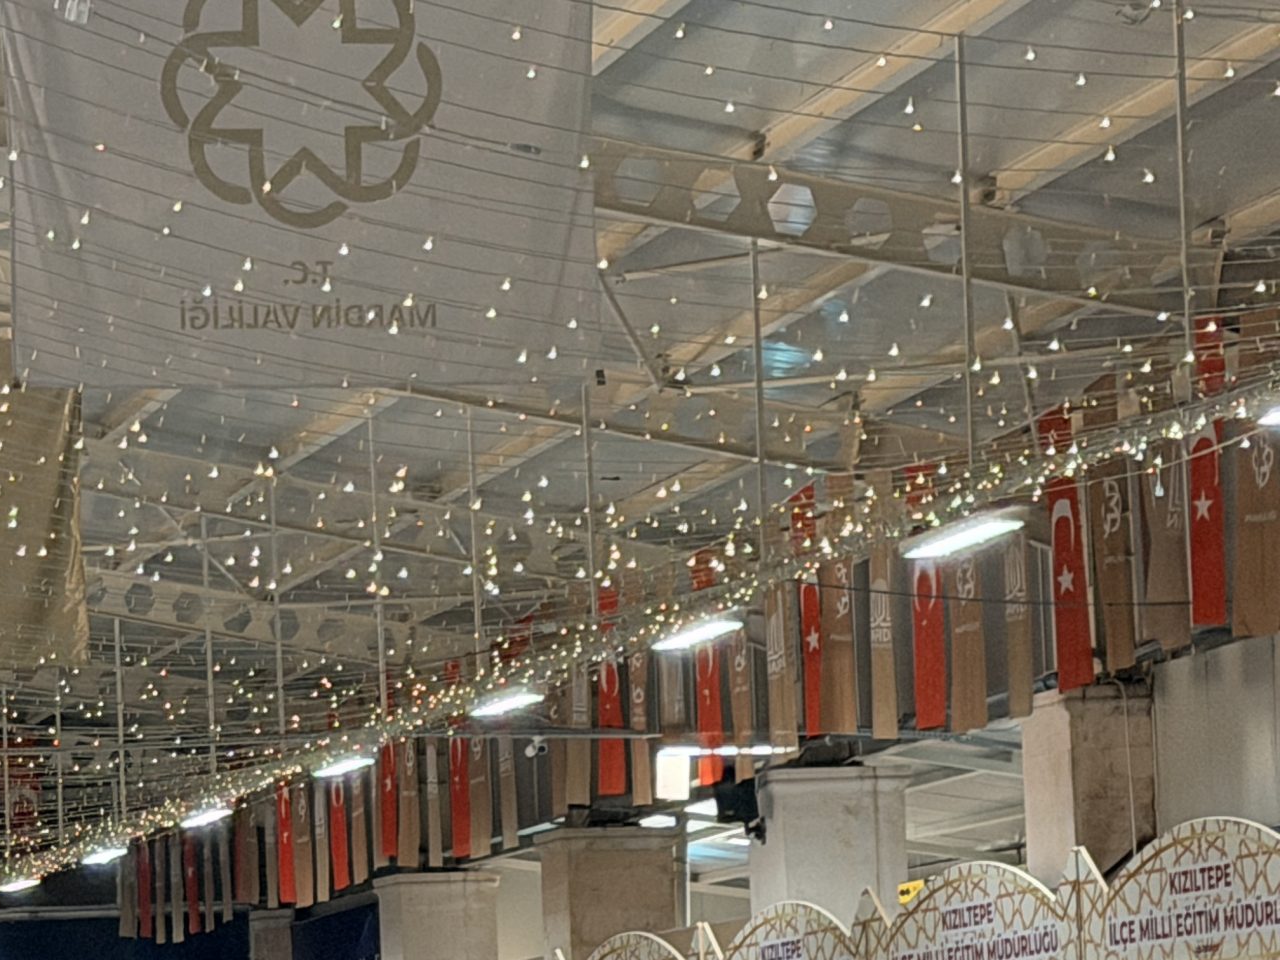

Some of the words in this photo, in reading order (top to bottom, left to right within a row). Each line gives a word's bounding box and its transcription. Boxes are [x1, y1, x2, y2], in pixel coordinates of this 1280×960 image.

[1169, 863, 1232, 895] KIZILTEPE
[942, 902, 993, 931] KIZILTEPE
[1109, 916, 1136, 951] İLÇE
[1139, 907, 1173, 941] MİLLİ
[1176, 902, 1220, 938] EĞİTİM
[987, 924, 1058, 960] MÜDÜRLÜĞÜ
